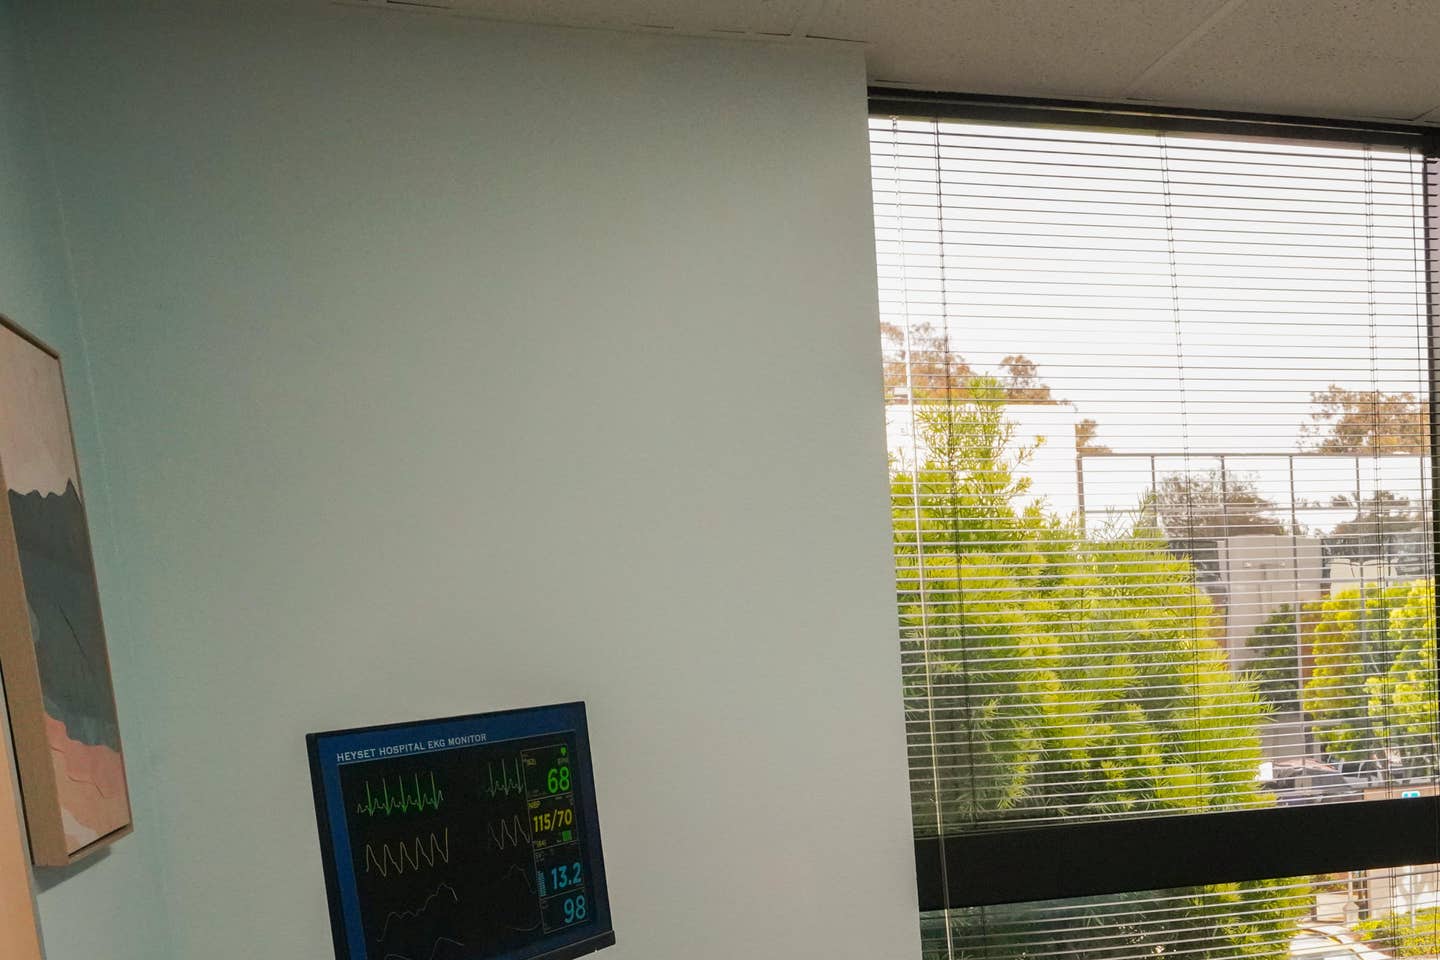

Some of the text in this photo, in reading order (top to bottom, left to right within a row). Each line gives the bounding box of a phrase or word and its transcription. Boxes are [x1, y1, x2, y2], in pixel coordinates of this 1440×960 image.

[337, 733, 487, 762] HEYSET HOSPITAL EKG MONITOR
[547, 766, 570, 793] 68
[533, 808, 573, 833] 115/70
[551, 862, 582, 890] 13.2
[563, 895, 586, 924] 98
